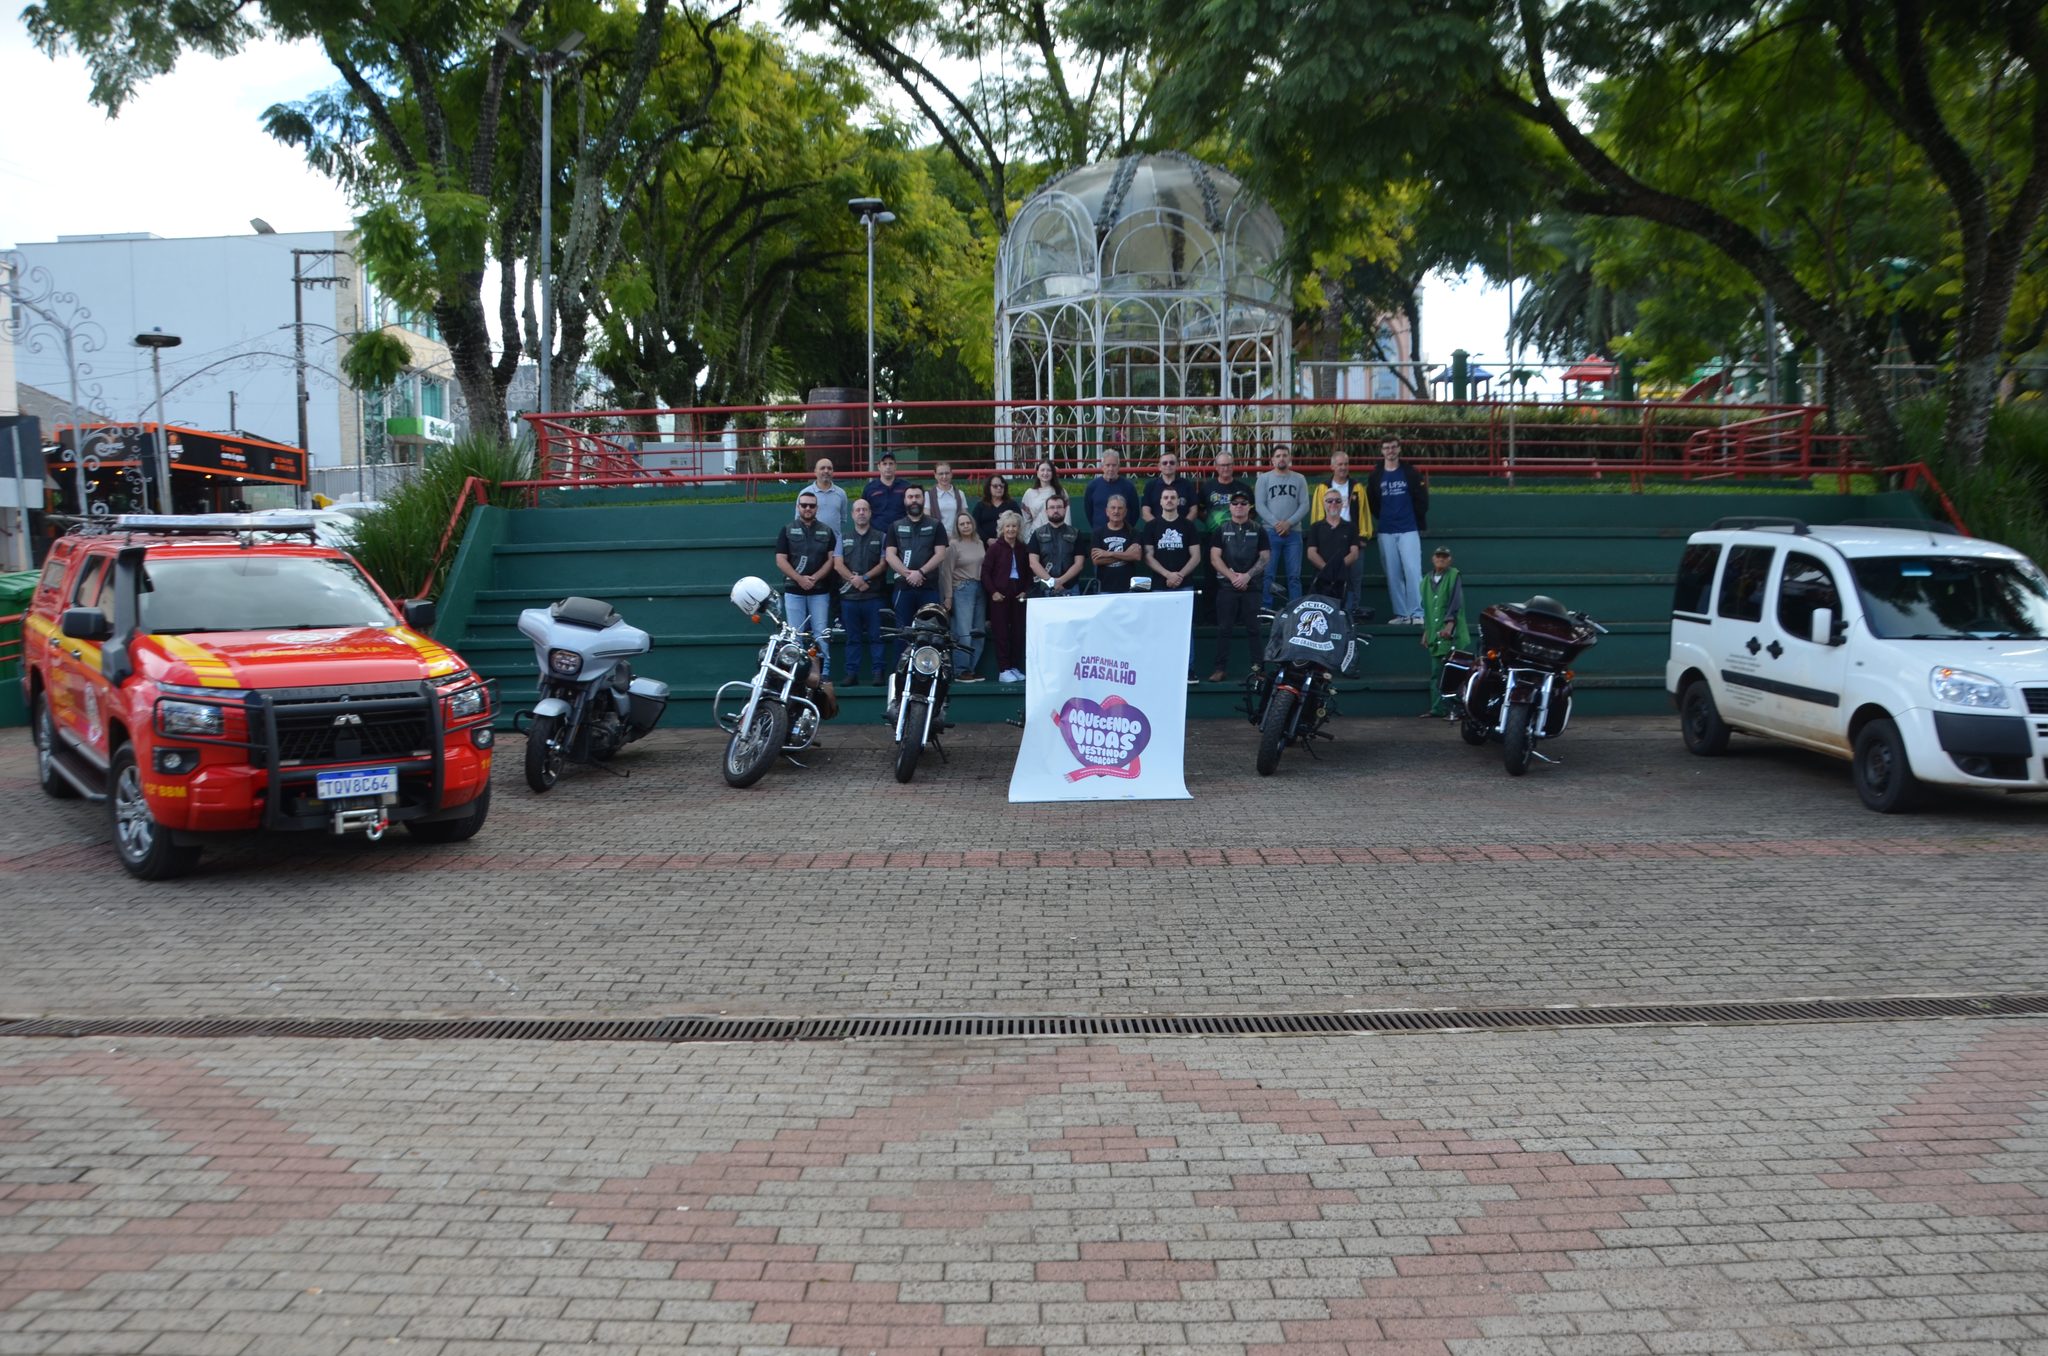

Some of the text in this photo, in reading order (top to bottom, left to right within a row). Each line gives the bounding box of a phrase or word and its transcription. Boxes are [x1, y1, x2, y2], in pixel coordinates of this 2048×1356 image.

[1269, 484, 1297, 499] TXC
[1081, 656, 1129, 670] CAMPANHA DO
[1074, 662, 1137, 686] AGASALHO
[1069, 708, 1142, 735] AQUECENDO
[1071, 723, 1137, 751] VIDAS
[1077, 744, 1128, 759] VESTINDO
